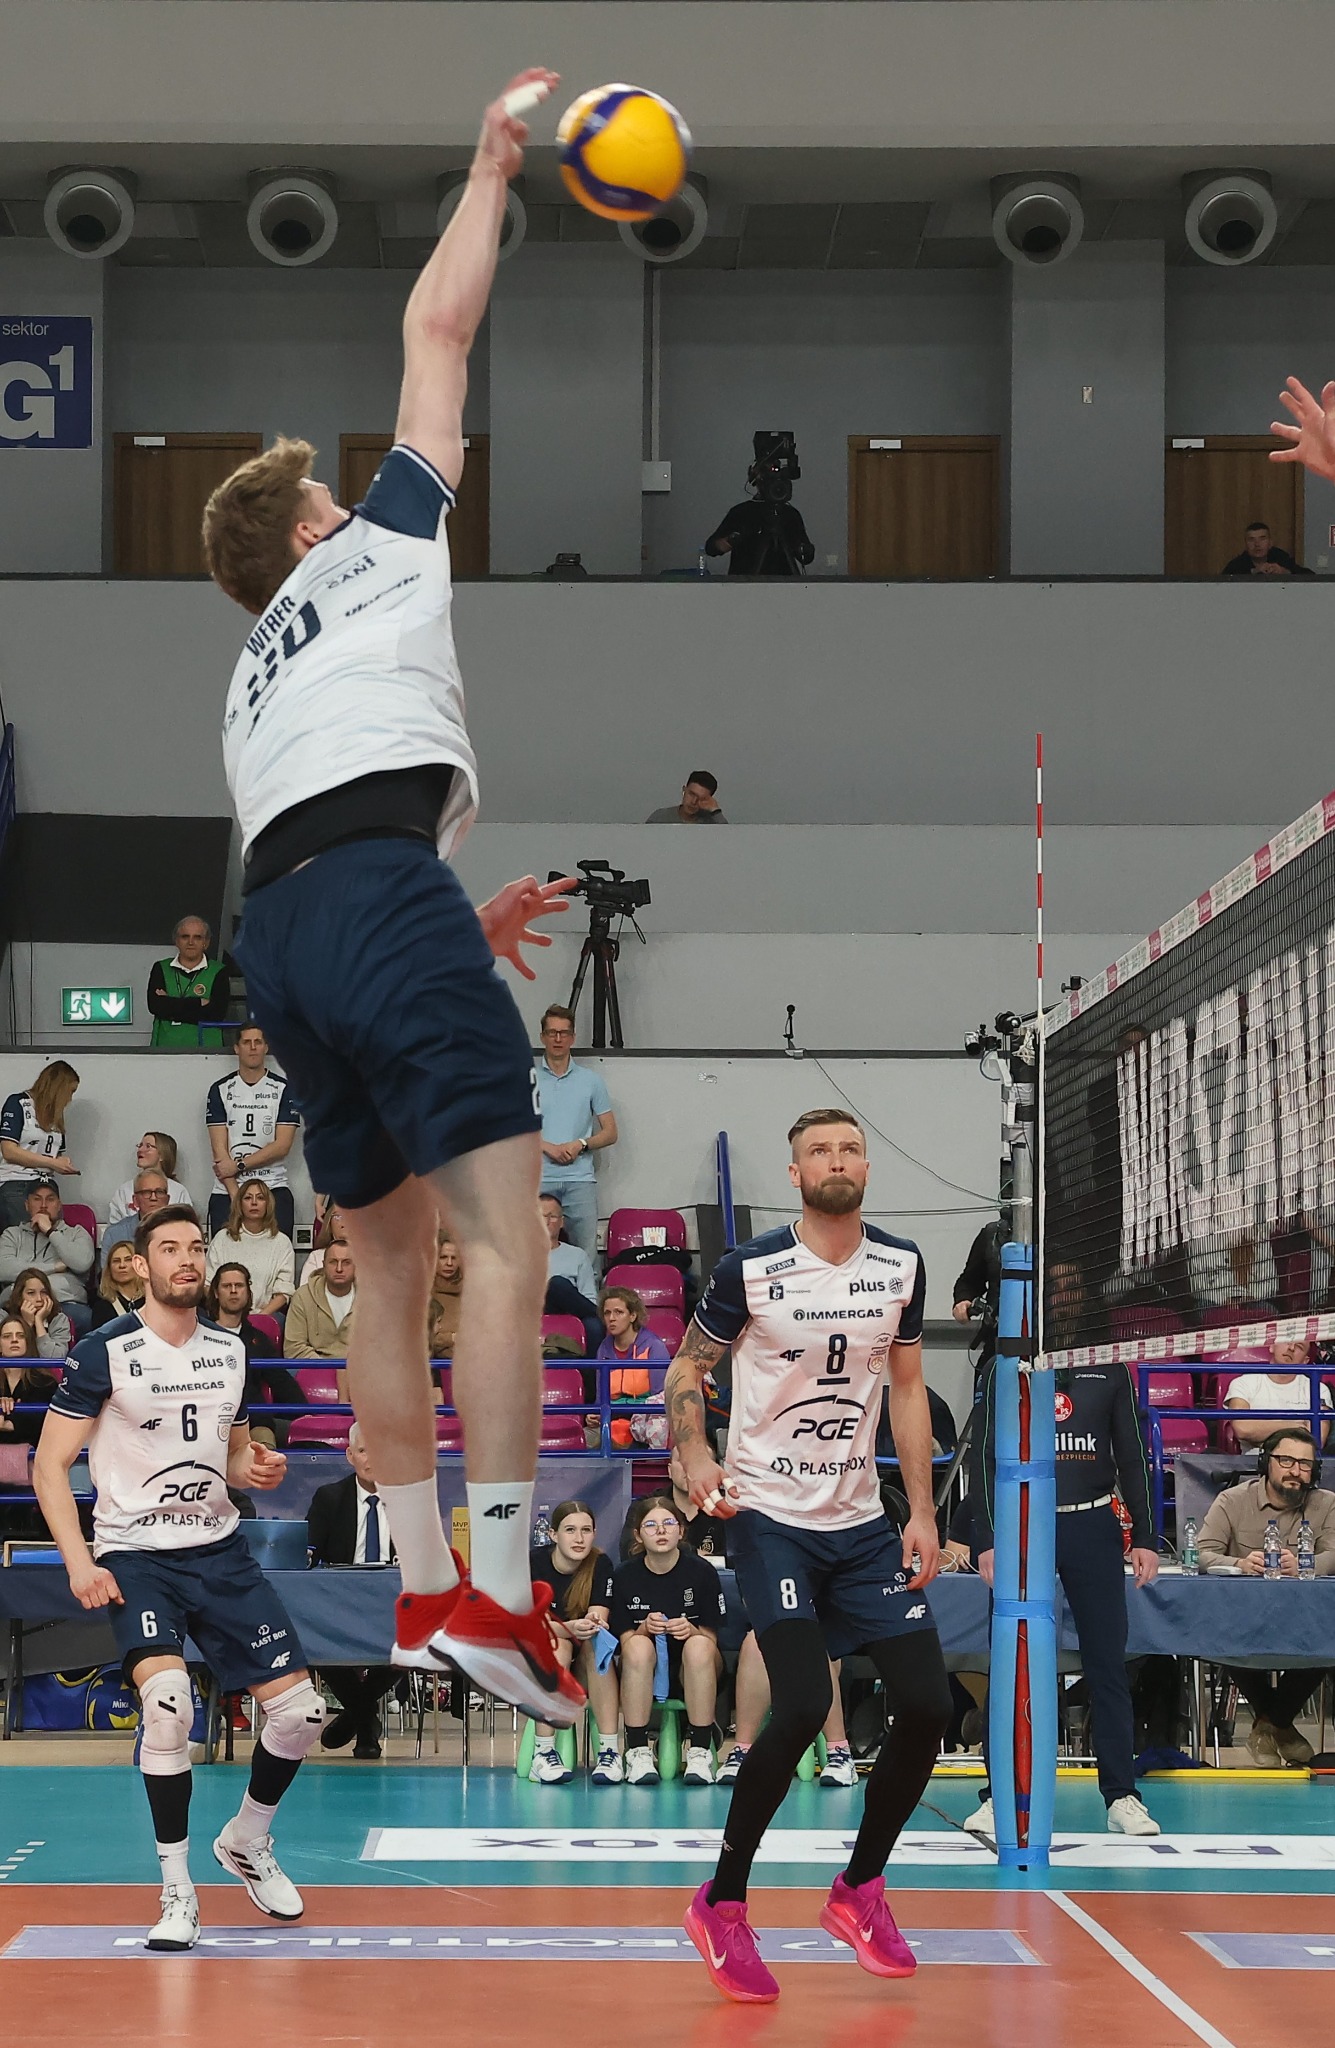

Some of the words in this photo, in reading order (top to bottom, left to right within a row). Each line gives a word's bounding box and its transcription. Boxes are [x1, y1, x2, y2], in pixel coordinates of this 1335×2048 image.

[2, 321, 50, 336] sektor
[246, 1114, 254, 1132] 8
[45, 1135, 54, 1154] 8
[766, 1258, 796, 1274] STARK
[866, 1253, 902, 1268] pomelo
[849, 1279, 886, 1296] plus
[806, 1309, 884, 1321] IMMERGAS
[779, 1349, 806, 1362] 4F
[826, 1333, 847, 1374] 8
[192, 1357, 224, 1372] plus
[161, 1381, 225, 1393] IMMERGAS
[140, 1418, 162, 1430] 4F
[182, 1403, 198, 1442] 6
[792, 1418, 859, 1441] PGE
[1055, 1432, 1097, 1452] ilink
[800, 1461, 846, 1476] PLAST
[159, 1481, 212, 1503] PGE
[483, 1503, 520, 1519] 4F
[162, 1513, 201, 1526] PLAST
[779, 1578, 798, 1610] 8
[904, 1604, 927, 1620] 4F
[140, 1610, 158, 1639] 6
[251, 1634, 272, 1650] PLAST
[272, 1628, 288, 1641] BOX
[270, 1650, 292, 1669] 4F
[113, 1937, 697, 1948] ECATHLON
